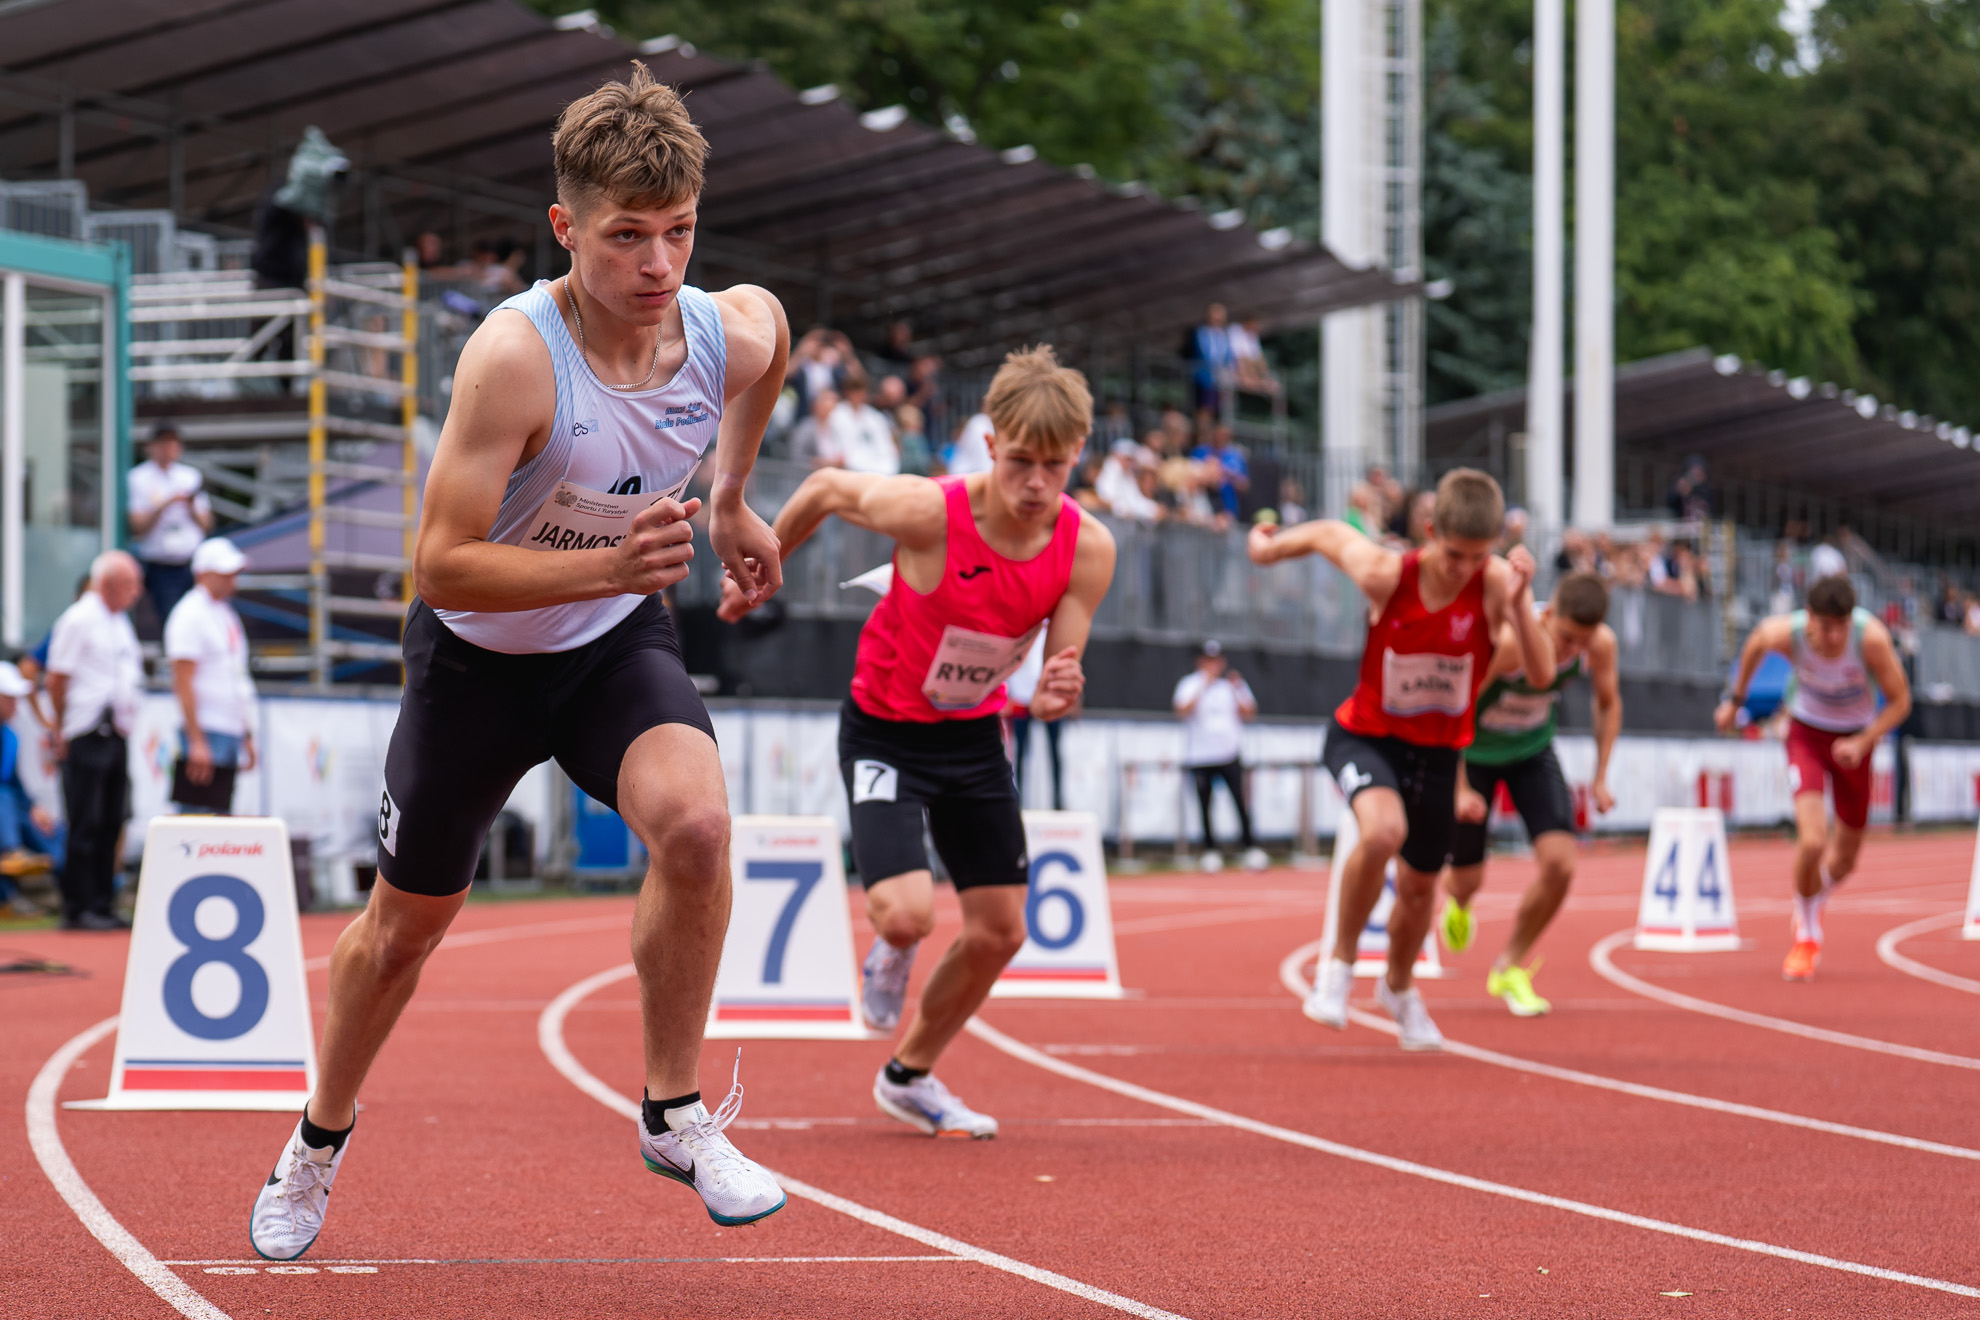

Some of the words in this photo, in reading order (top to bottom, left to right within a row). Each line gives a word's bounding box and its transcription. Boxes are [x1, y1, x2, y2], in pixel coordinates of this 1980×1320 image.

[576, 502, 597, 512] Sportu
[579, 497, 619, 509] Ministerstwo
[531, 521, 627, 551] JARMOS
[865, 765, 887, 794] 7
[380, 790, 391, 840] 8
[198, 842, 264, 858] polanik
[1025, 851, 1085, 950] 6
[1655, 841, 1678, 915] 4
[1698, 841, 1720, 916] 4
[745, 861, 824, 984] 7
[162, 873, 270, 1041] 8
